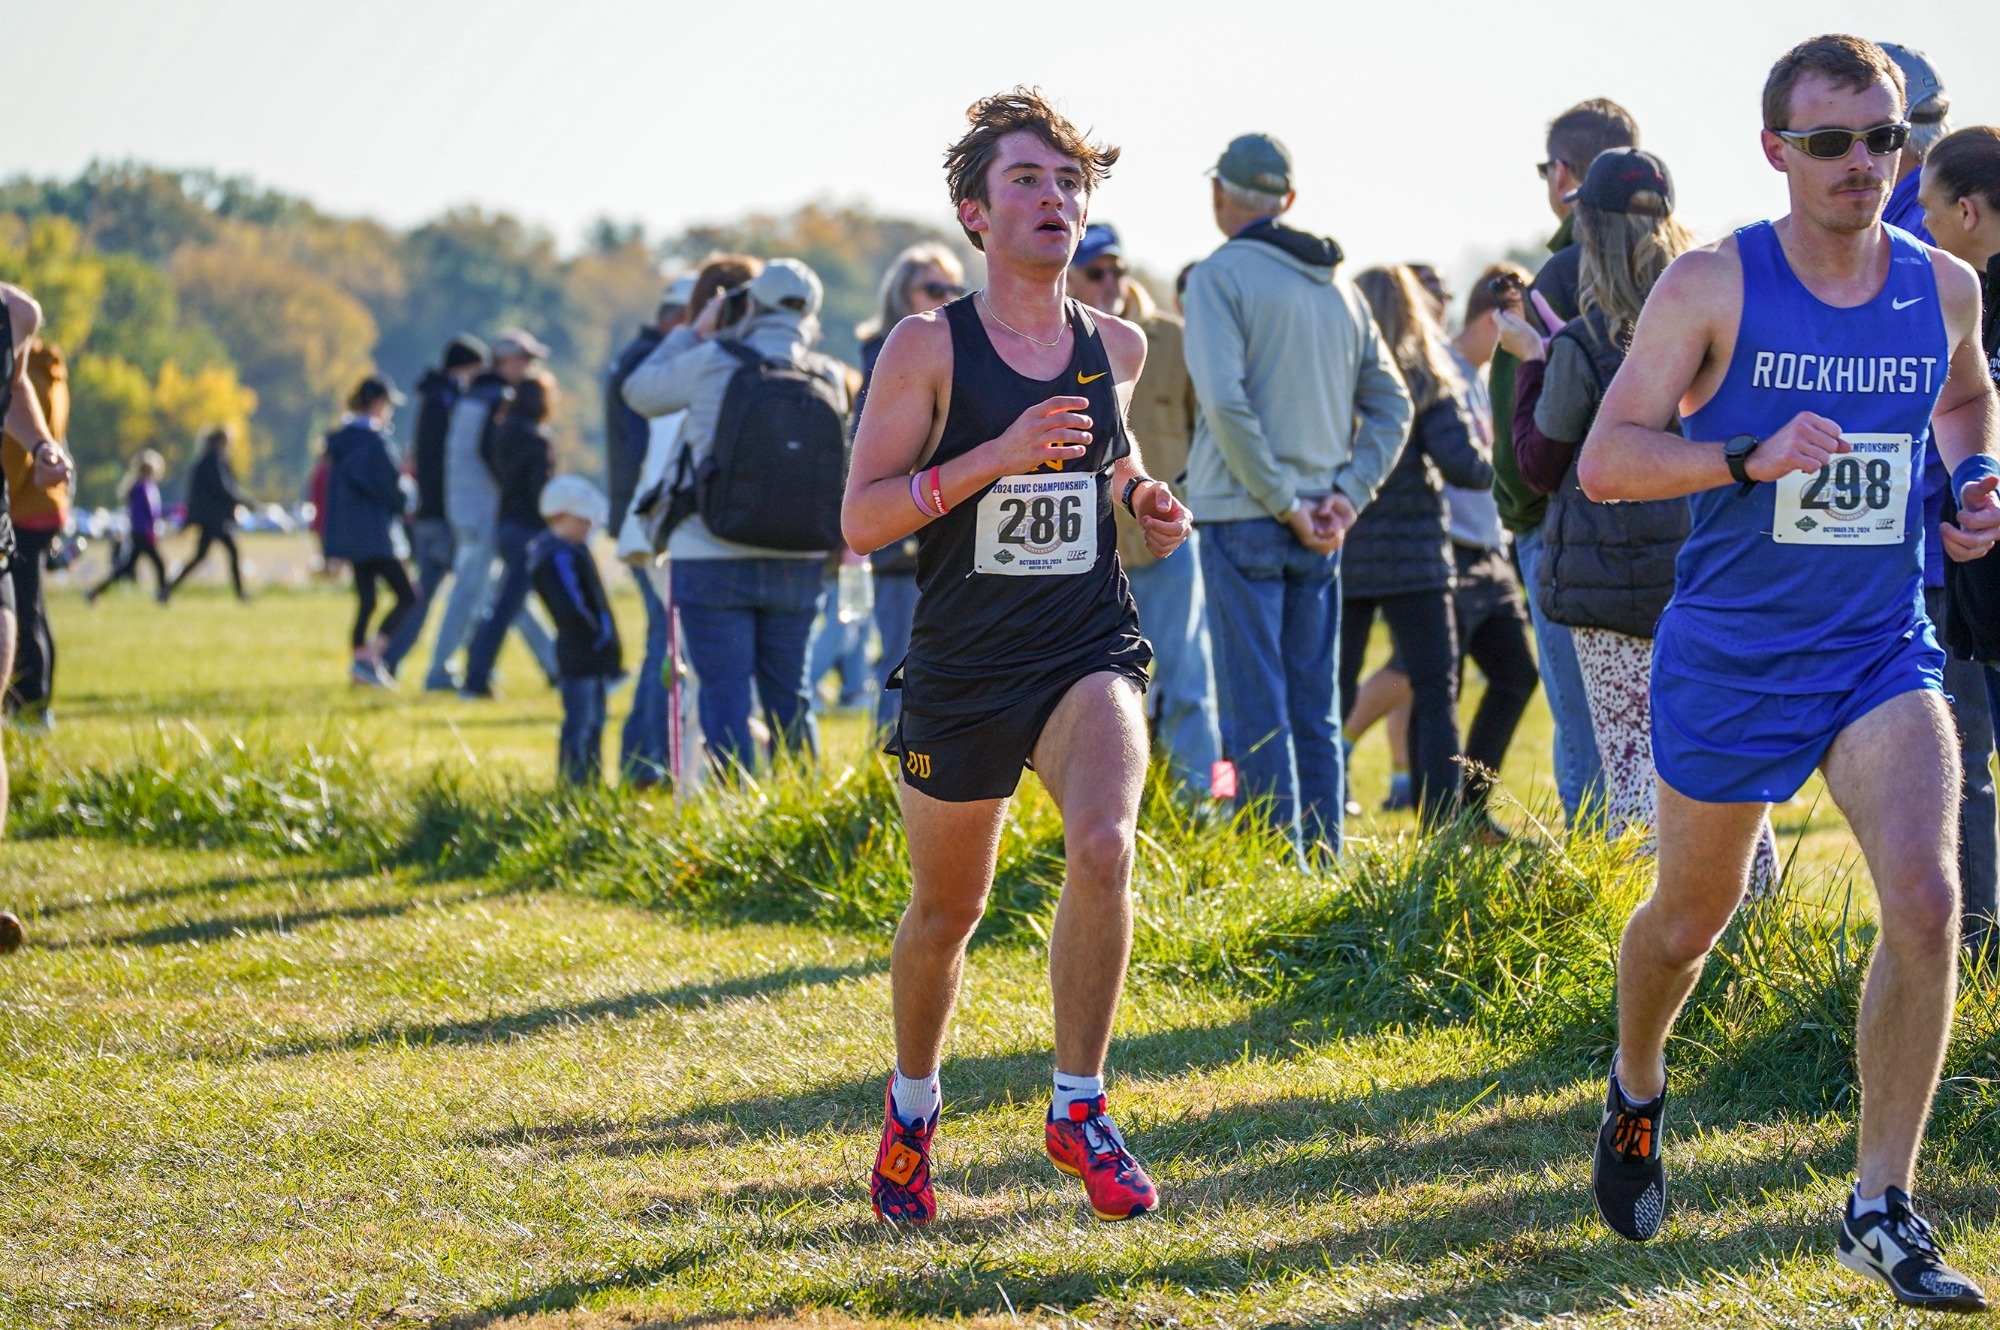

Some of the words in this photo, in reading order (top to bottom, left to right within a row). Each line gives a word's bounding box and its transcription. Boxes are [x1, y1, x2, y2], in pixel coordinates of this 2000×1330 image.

[1752, 351, 1937, 394] ROCKHURST
[1851, 442, 1899, 453] MPIONSHIPS
[993, 484, 1012, 494] 2024
[1014, 484, 1031, 494] GLVC
[1033, 480, 1088, 492] CHAMPIONSHIPS
[1800, 458, 1891, 510] 298
[998, 495, 1081, 544] 286
